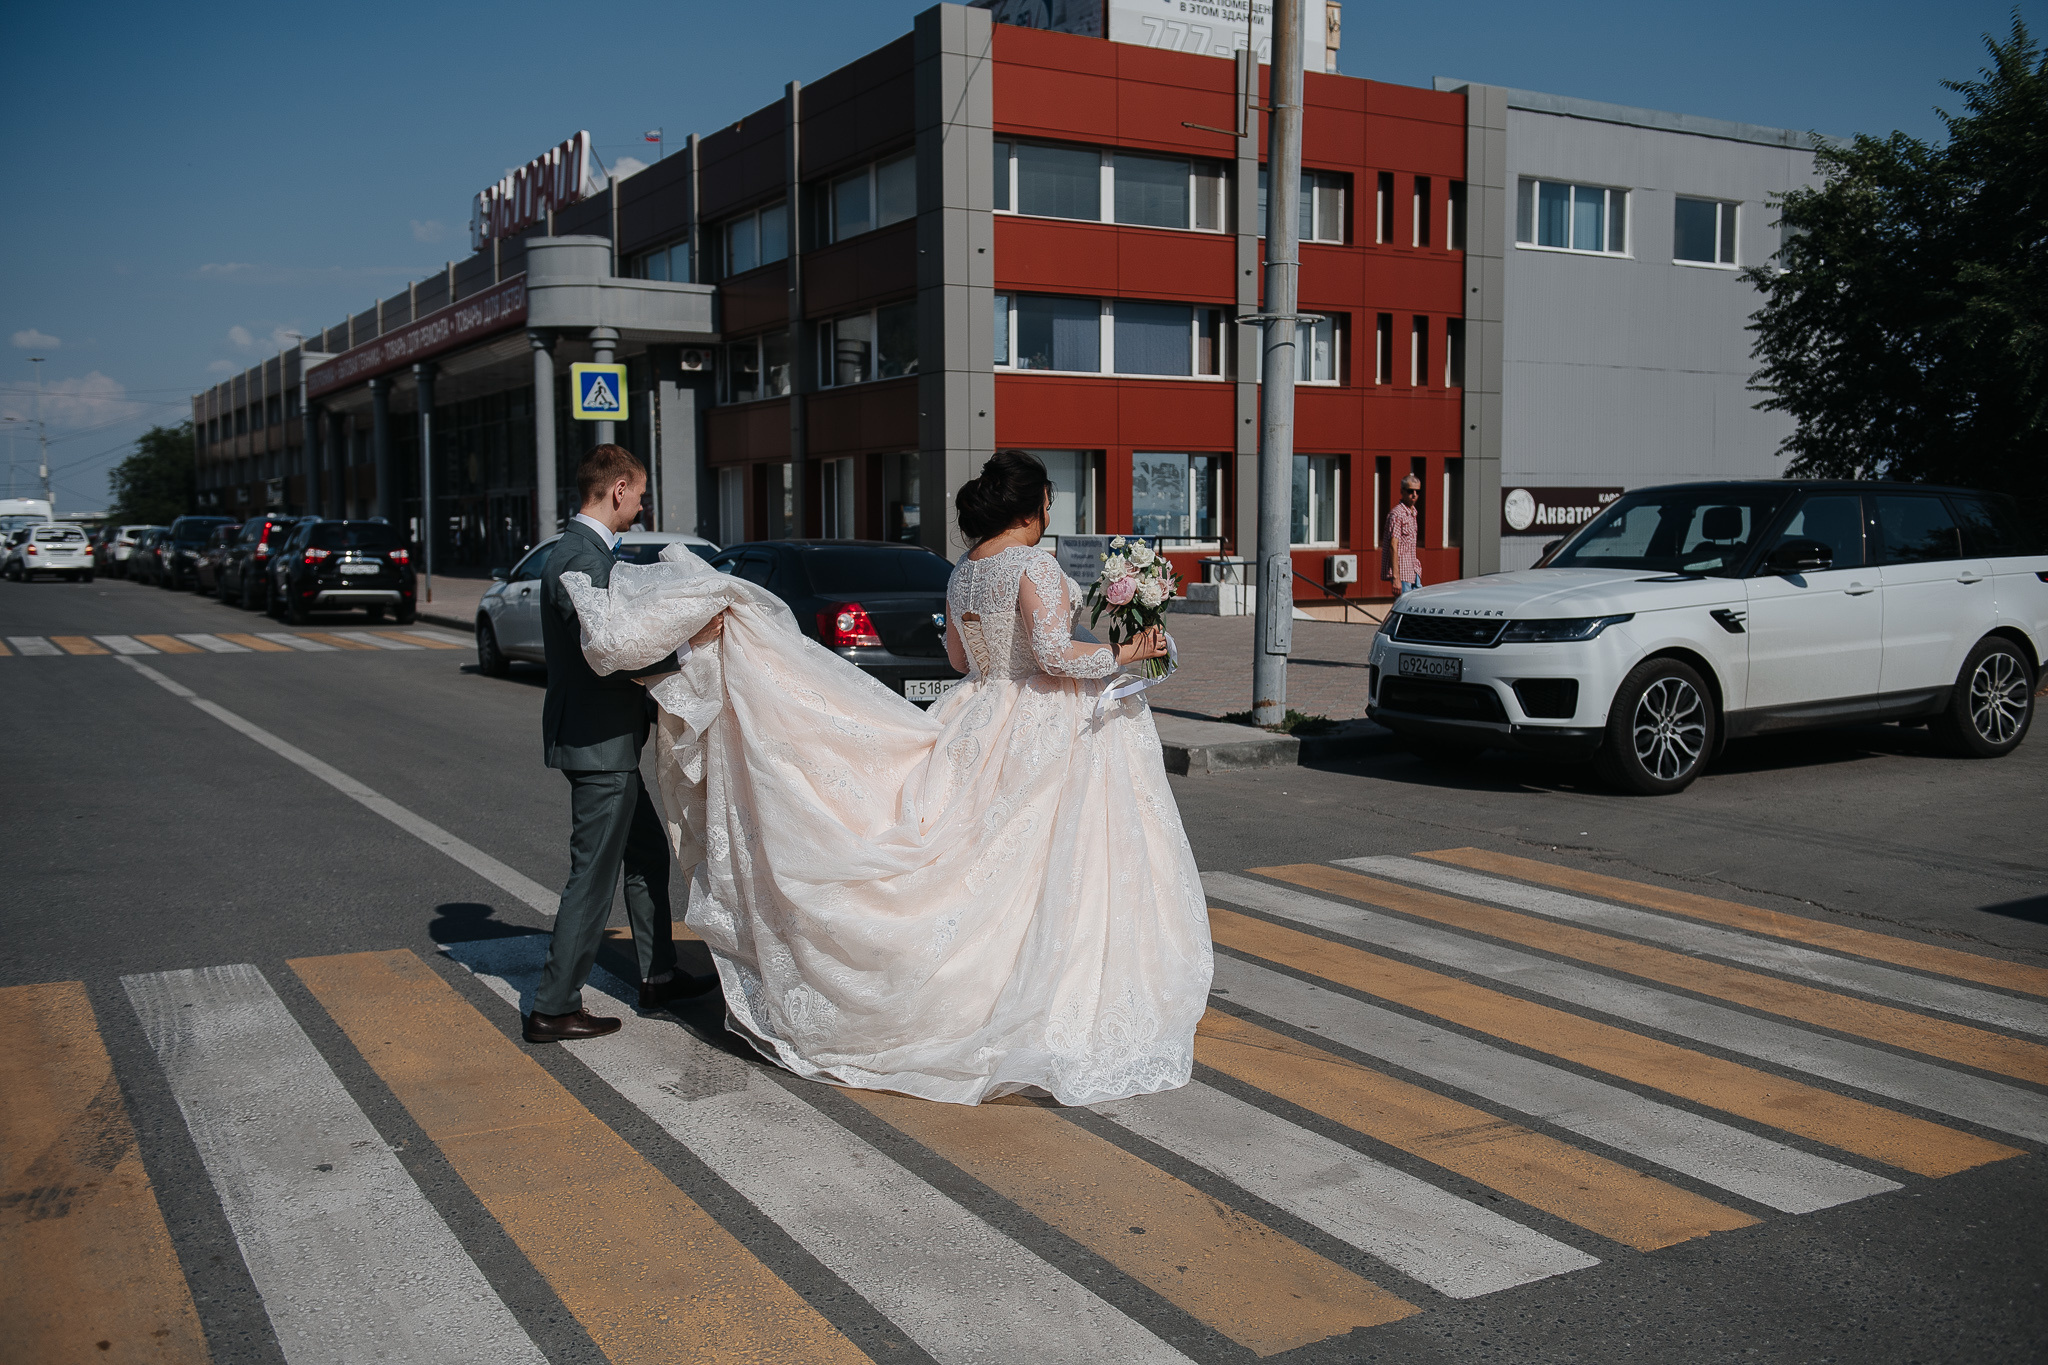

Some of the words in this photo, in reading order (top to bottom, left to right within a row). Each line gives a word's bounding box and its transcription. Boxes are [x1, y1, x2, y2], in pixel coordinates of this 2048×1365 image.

[1180, 1, 1187, 12] В
[1190, 3, 1219, 17] ЭТОМ
[1222, 9, 1265, 25] ЗДАНИИ
[1216, 0, 1271, 15] ПОМЕЩЕН
[1142, 15, 1272, 61] 777-54
[1406, 606, 1445, 615] RANGE
[1445, 660, 1456, 673] 64
